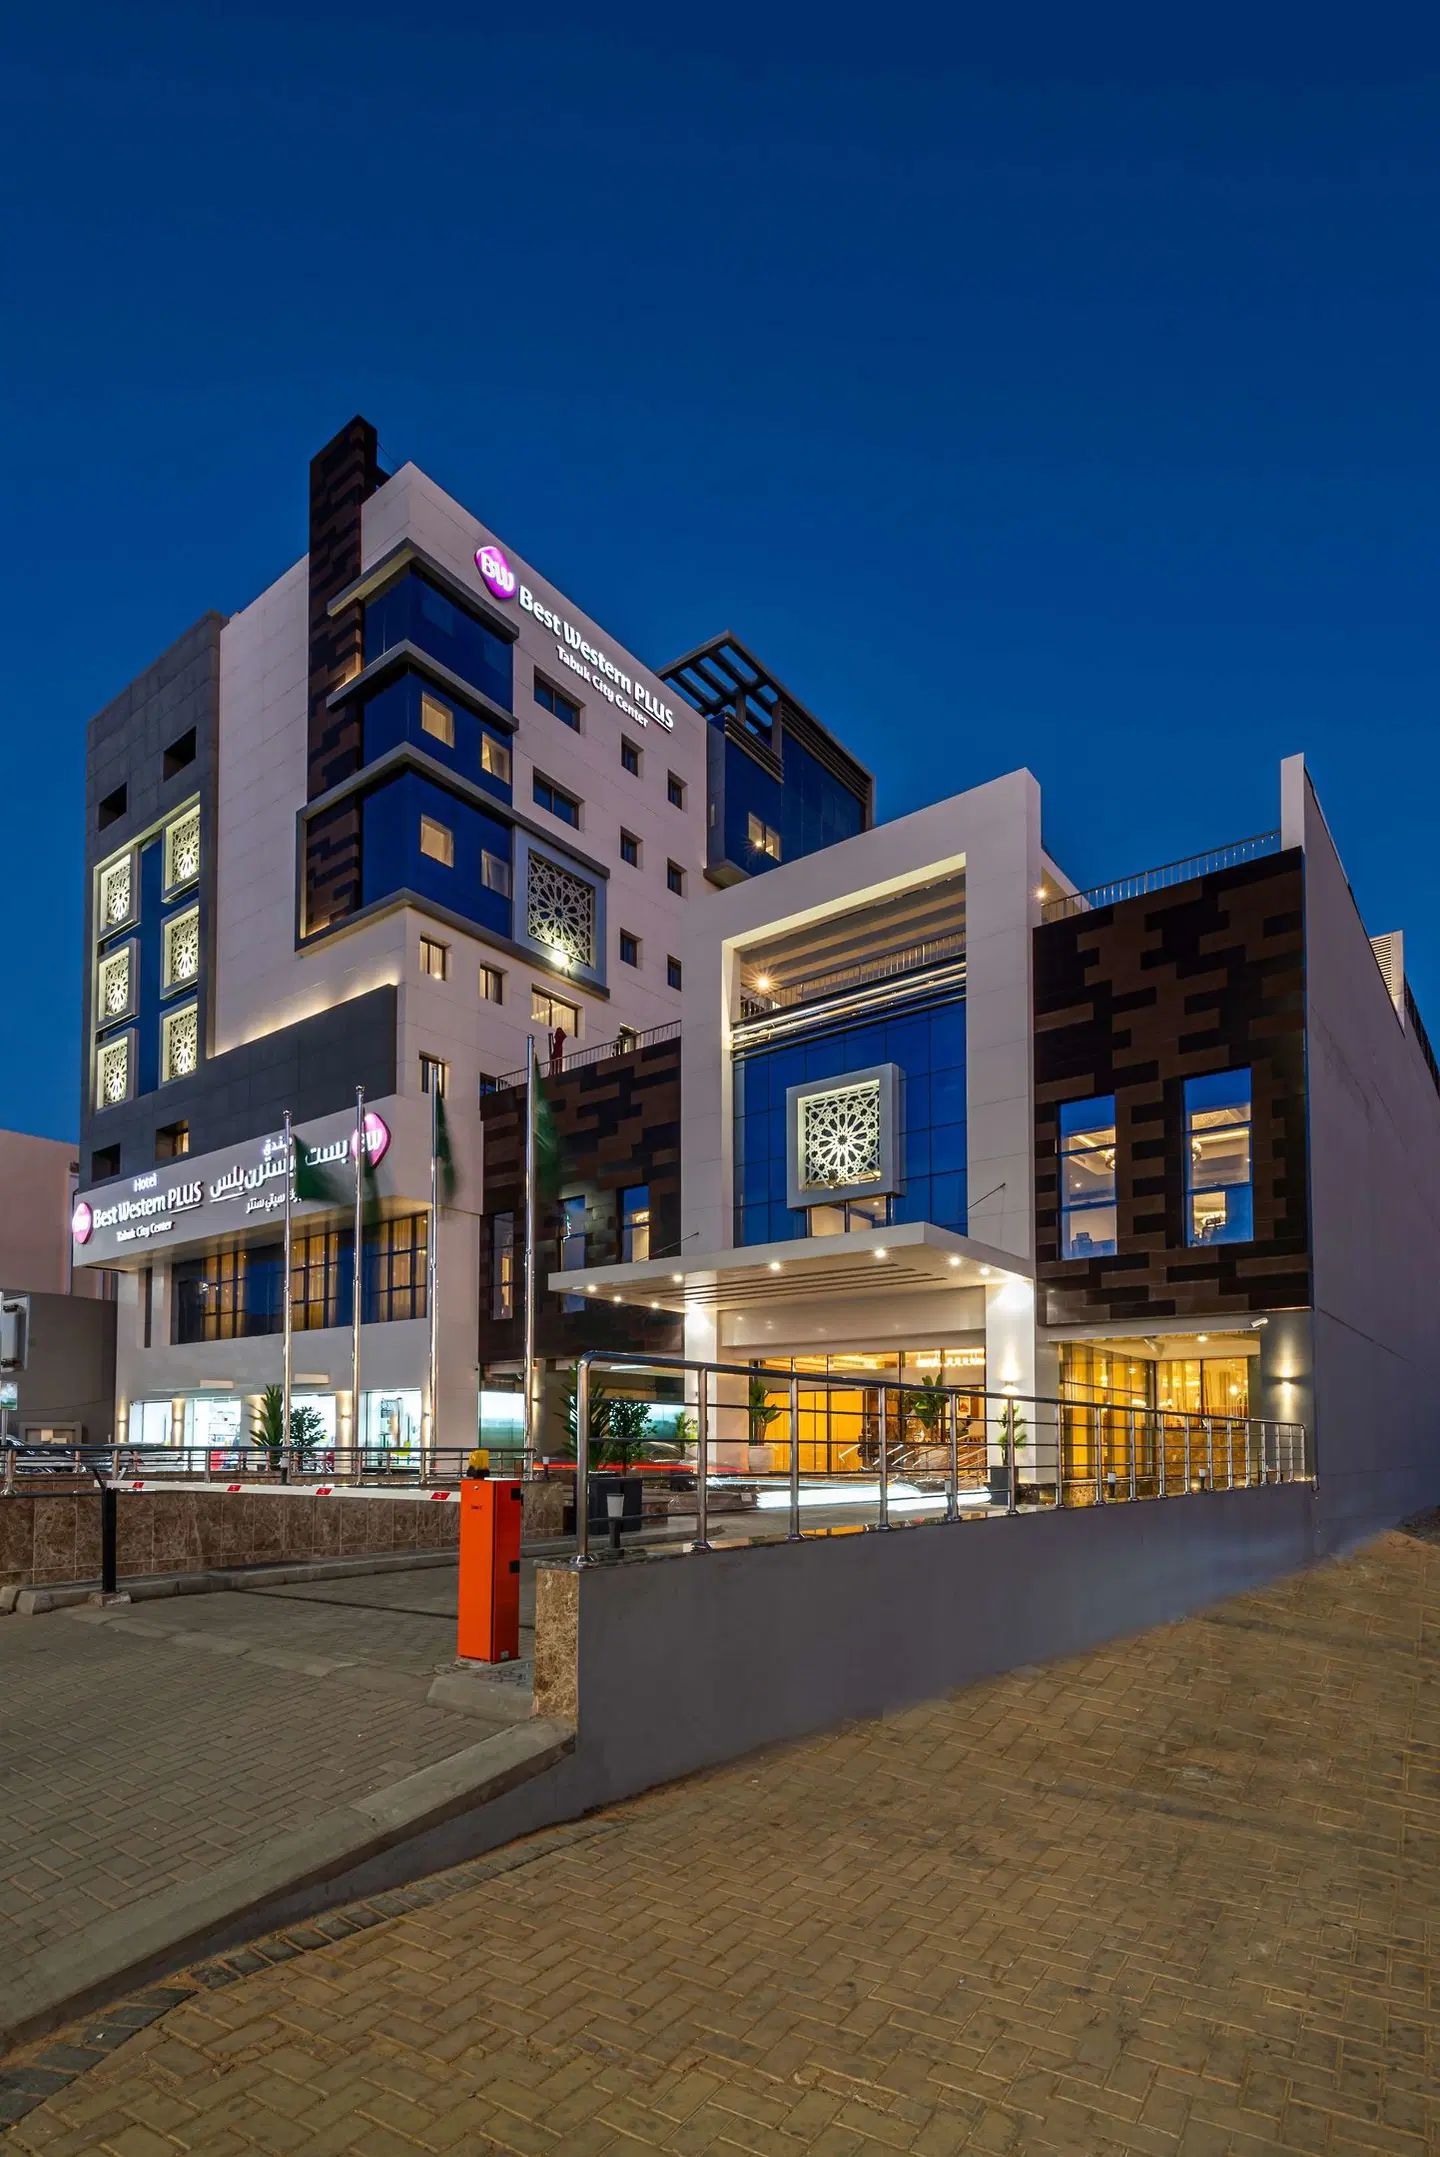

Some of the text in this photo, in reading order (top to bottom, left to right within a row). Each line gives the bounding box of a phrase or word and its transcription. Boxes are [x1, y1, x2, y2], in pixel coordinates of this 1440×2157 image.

[480, 552, 515, 592] BW
[519, 585, 674, 729] Best Western PLUS
[556, 645, 649, 728] Tabuk City Center
[305, 1139, 348, 1164] بست
[133, 1172, 158, 1192] Hotel
[210, 1165, 245, 1198] بلس
[92, 1208, 118, 1229] Best
[118, 1195, 167, 1221] Western
[167, 1181, 202, 1209] PLUS
[150, 1220, 173, 1234] Center
